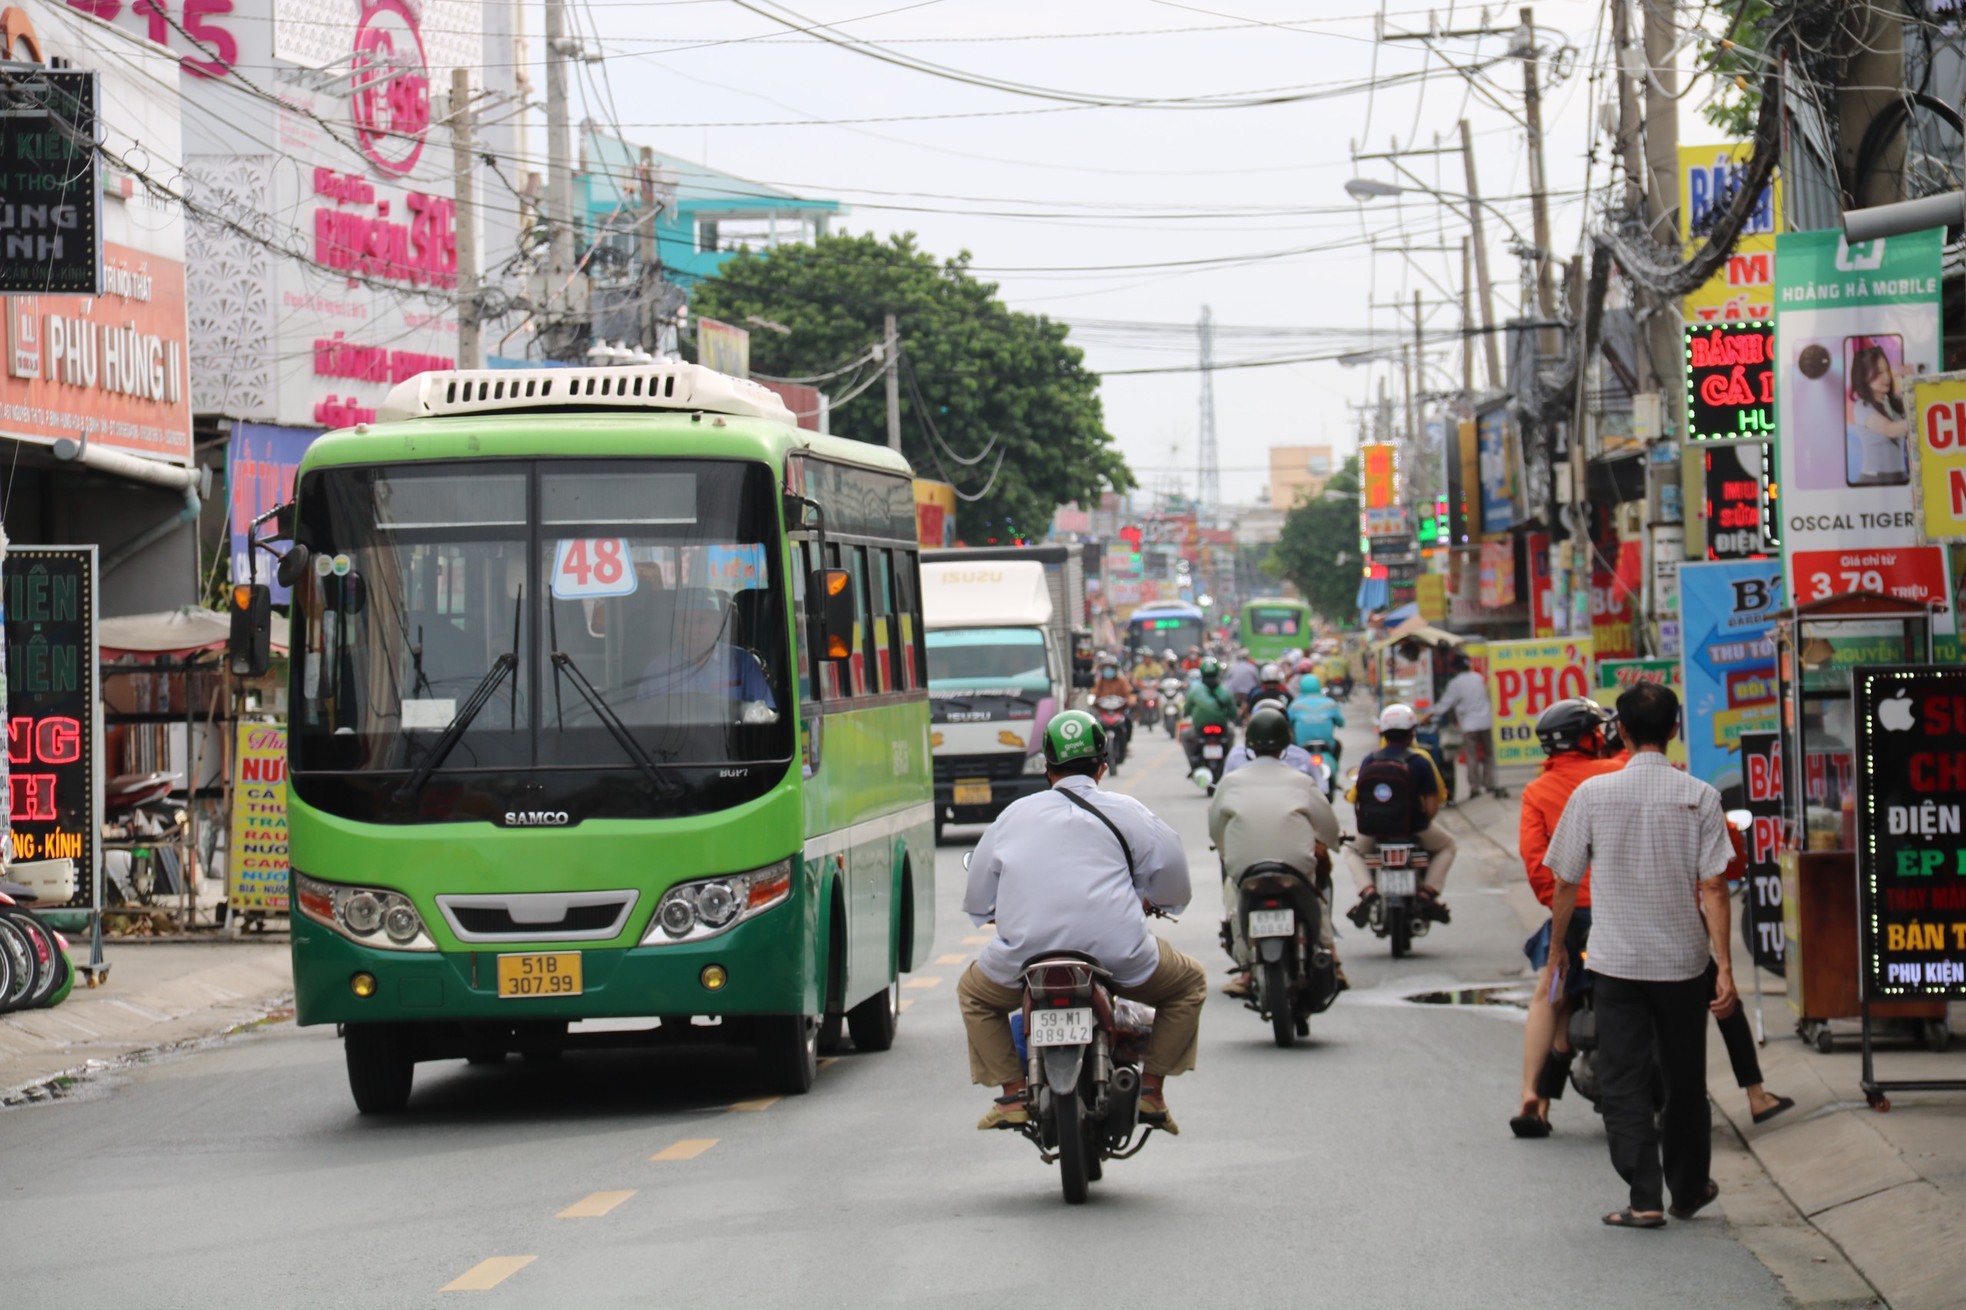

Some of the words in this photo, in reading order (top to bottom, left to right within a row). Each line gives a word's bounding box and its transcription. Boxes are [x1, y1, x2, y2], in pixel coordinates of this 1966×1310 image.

[1783, 281, 1840, 302] HOÀNG
[1845, 277, 1868, 298] HÀ
[1873, 277, 1937, 297] MOBILE
[50, 297, 97, 388] PHÚ
[105, 319, 164, 401] HƯNG
[1691, 329, 1764, 368] BÁNH
[1701, 365, 1756, 406] CÁ
[1790, 515, 1854, 531] OSCAL
[1860, 512, 1914, 528] TIGER
[562, 537, 624, 585] 48
[1840, 555, 1861, 567] Giá
[1862, 553, 1880, 566] chỉ
[1881, 553, 1897, 565] từ
[943, 571, 1003, 584] ISUZU
[1891, 583, 1928, 601] TRIỆU
[1495, 644, 1589, 717] PHỞ
[946, 711, 991, 722] ISUZU
[1064, 740, 1085, 751] gojek
[505, 812, 569, 825] SAMCO
[1887, 799, 1961, 841] ĐIỆN
[45, 826, 82, 859] KÍNH
[1896, 845, 1945, 876] ÉP
[1887, 918, 1945, 951] BÁN
[522, 957, 557, 974] 51B
[1888, 963, 1922, 987] PHỤ
[1925, 959, 1965, 987] KIỆN
[508, 976, 573, 995] 307.99
